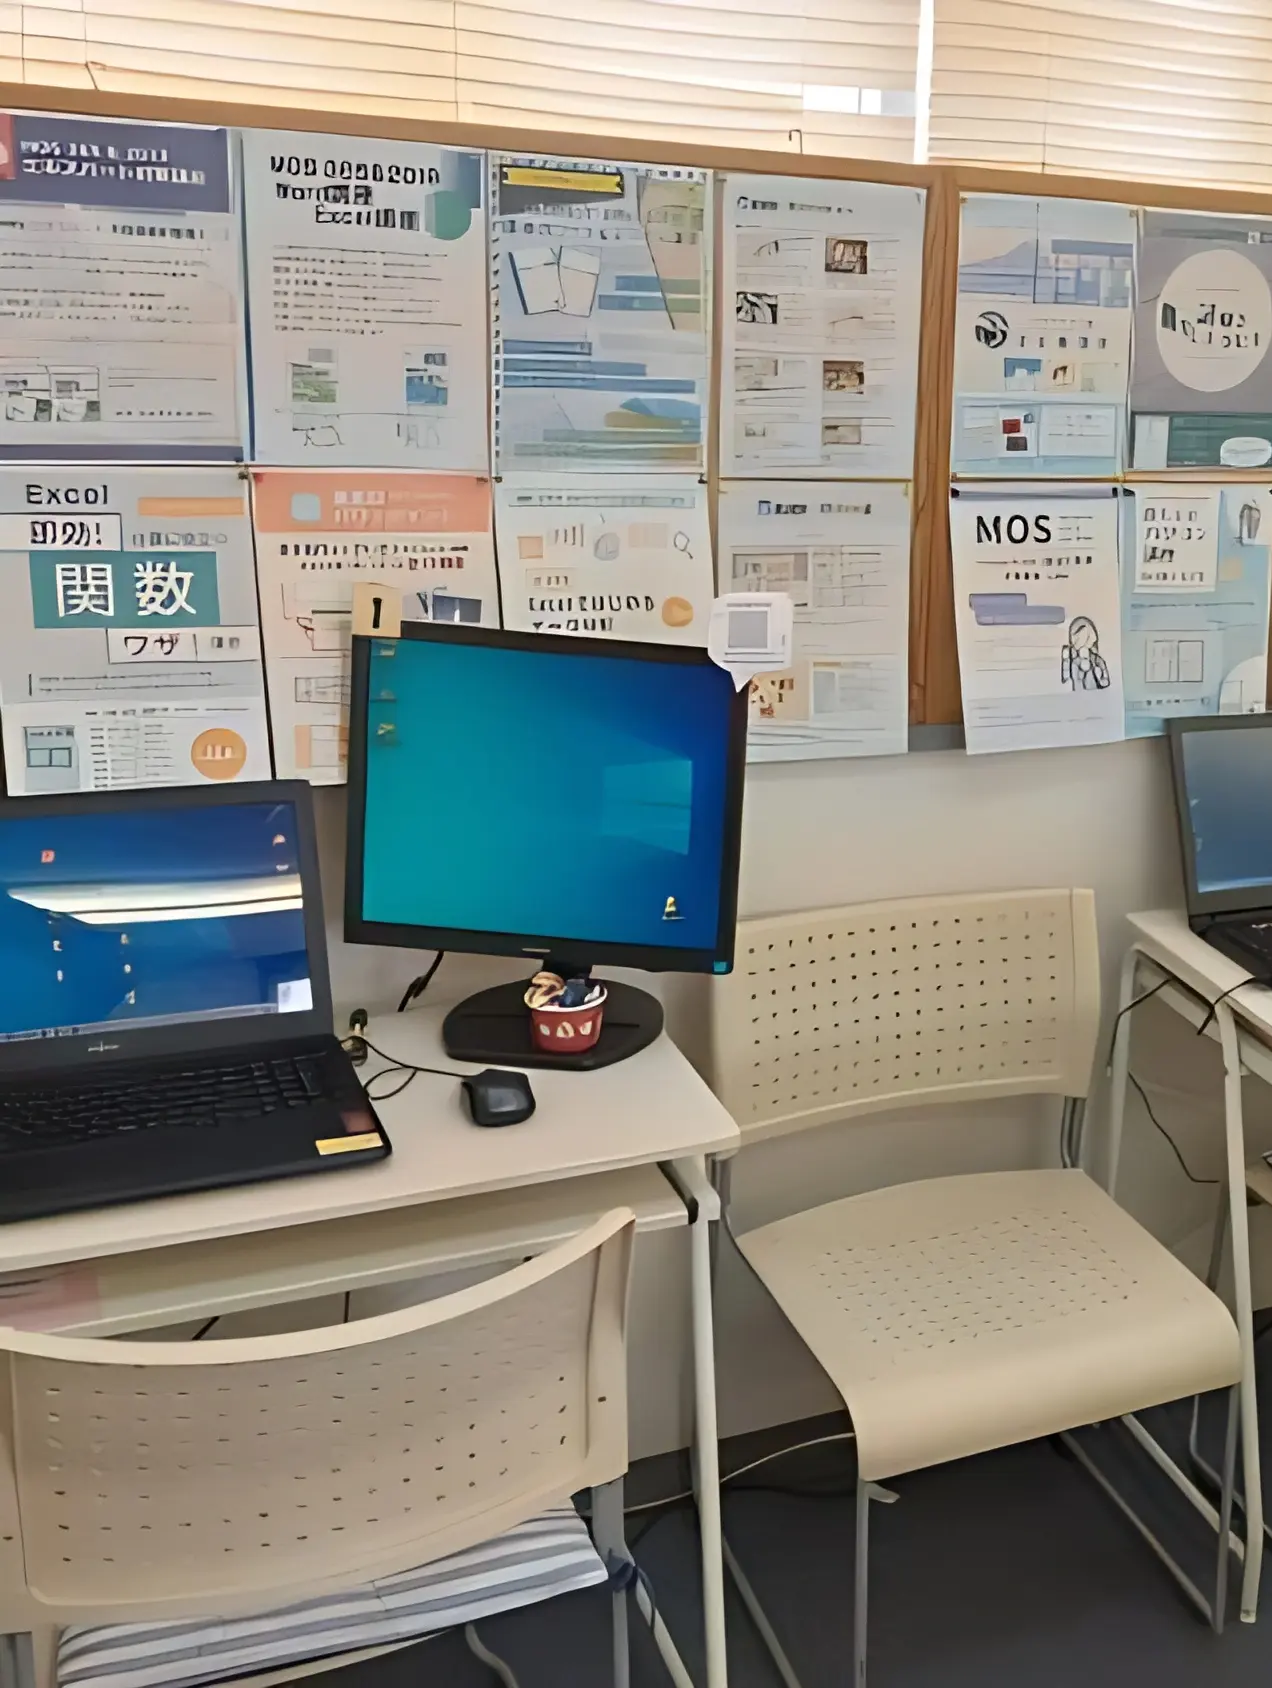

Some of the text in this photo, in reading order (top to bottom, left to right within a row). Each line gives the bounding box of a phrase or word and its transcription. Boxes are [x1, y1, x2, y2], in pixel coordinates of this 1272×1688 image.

[976, 514, 1051, 544] MOS
[55, 560, 197, 618] 関数
[372, 597, 382, 629] 1
[123, 633, 179, 656] ワザ
